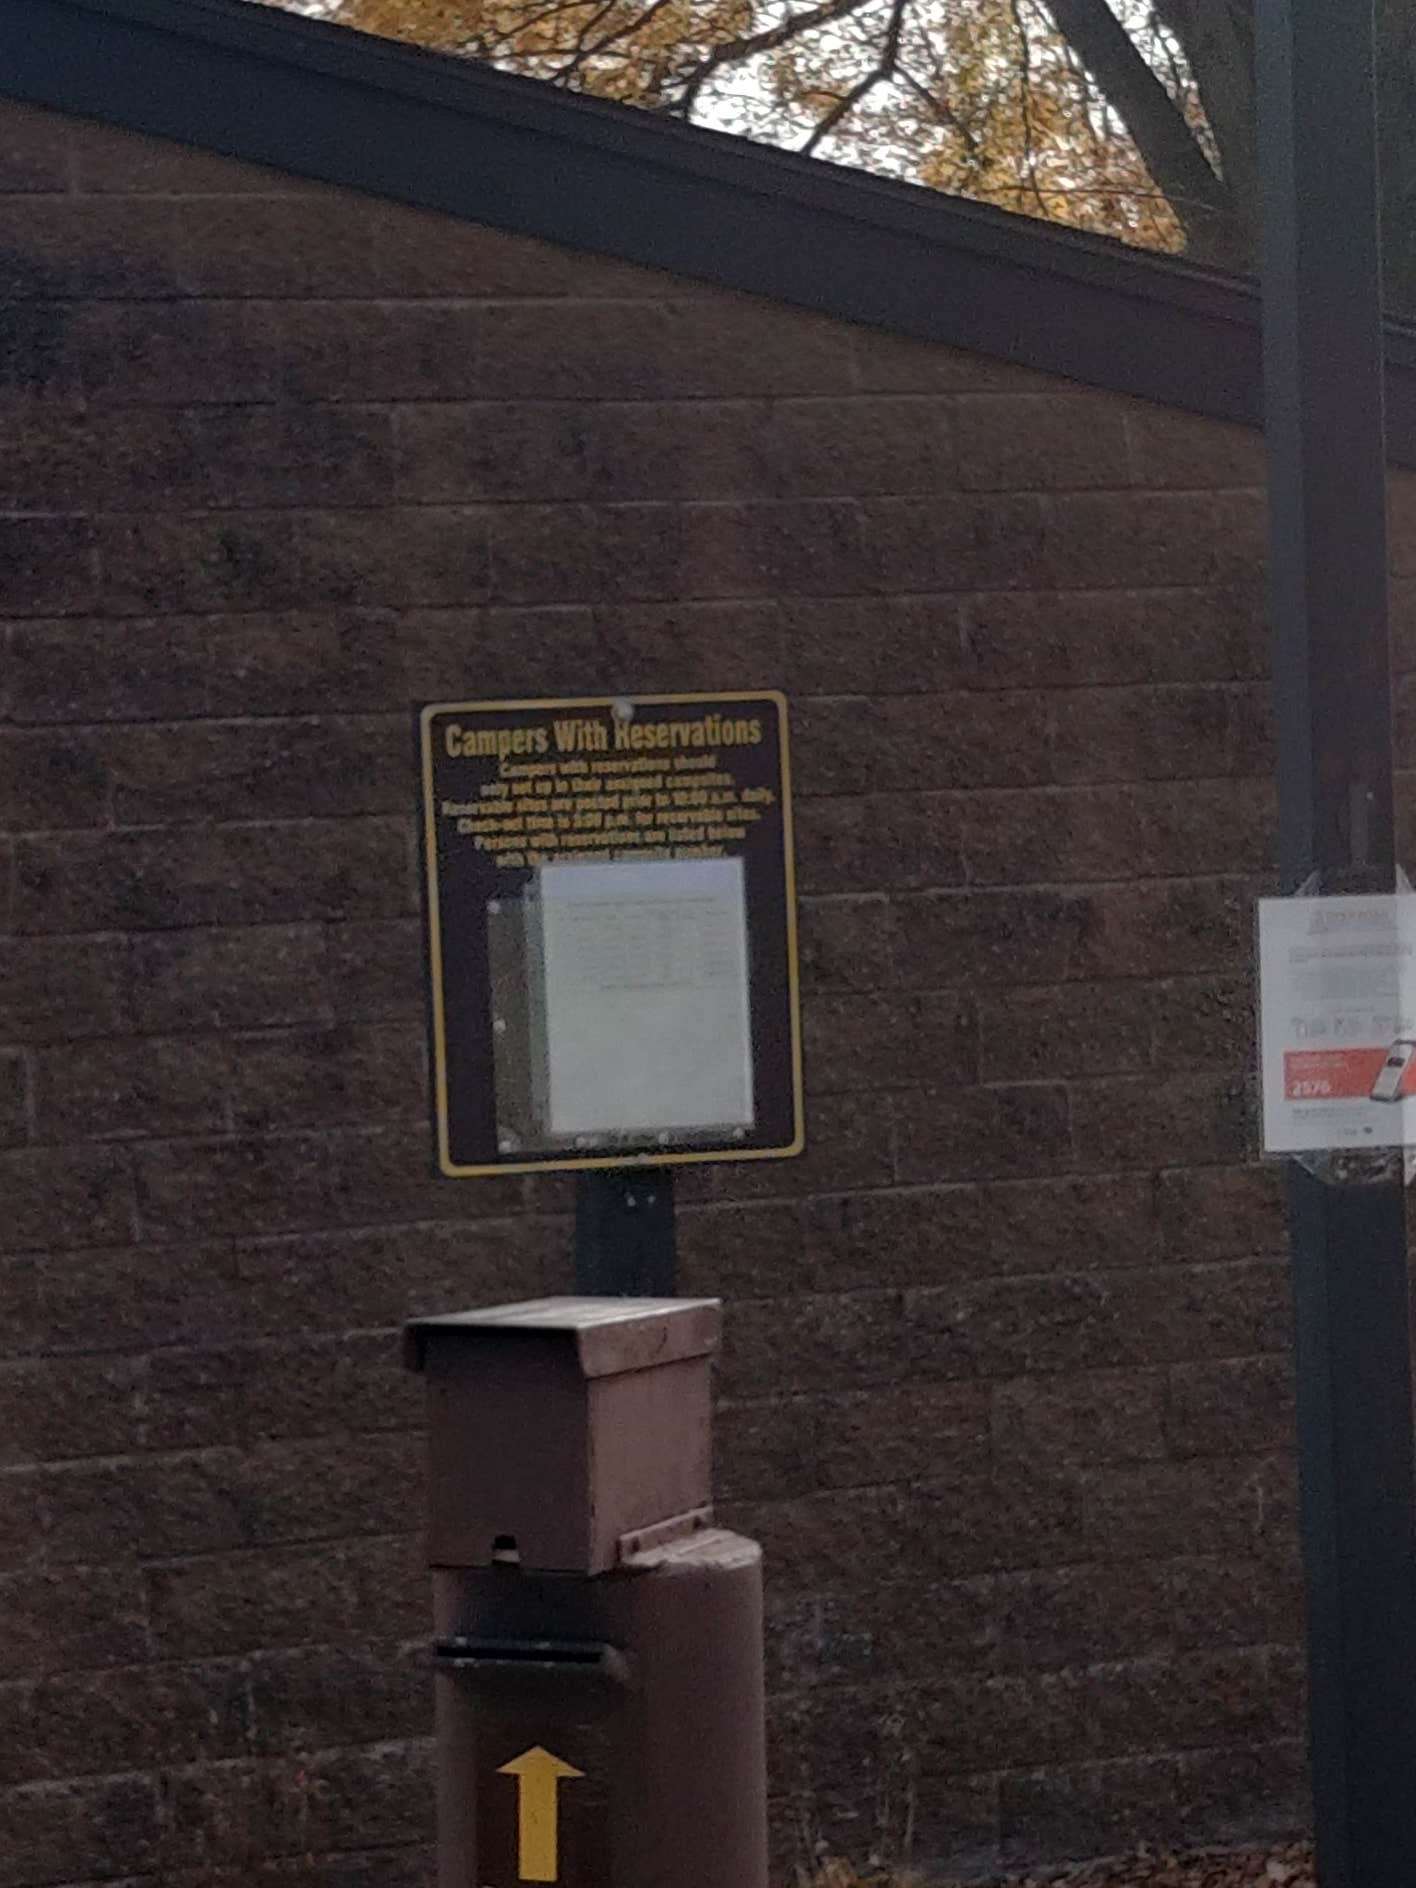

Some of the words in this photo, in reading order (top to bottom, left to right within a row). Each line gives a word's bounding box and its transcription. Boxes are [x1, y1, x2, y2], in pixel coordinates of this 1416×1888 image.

[445, 724, 547, 759] Campers
[554, 719, 608, 750] With
[615, 715, 761, 749] Reservations
